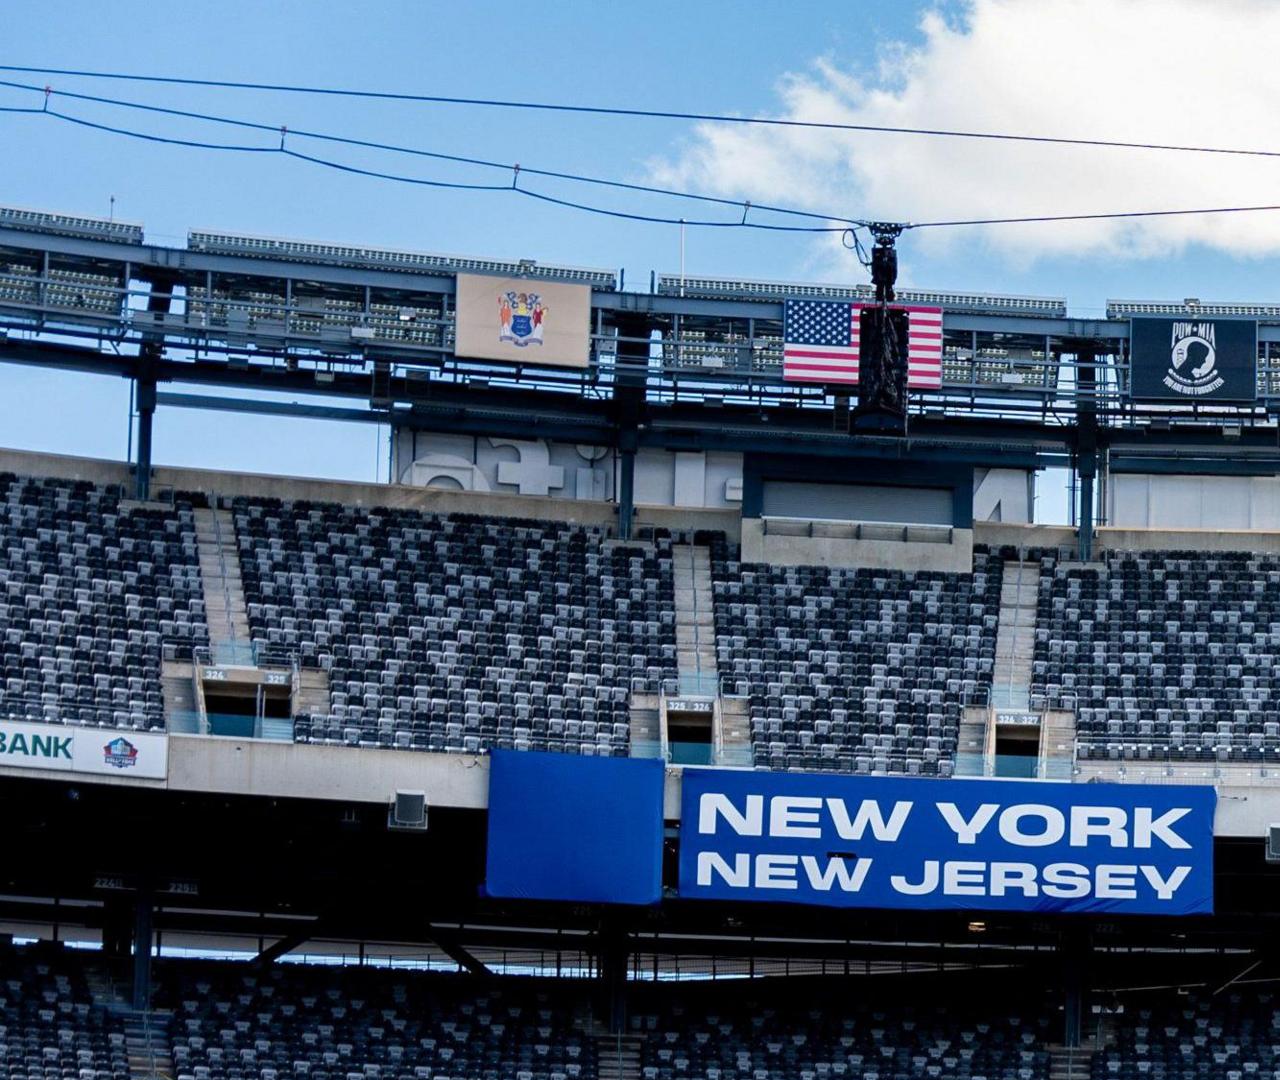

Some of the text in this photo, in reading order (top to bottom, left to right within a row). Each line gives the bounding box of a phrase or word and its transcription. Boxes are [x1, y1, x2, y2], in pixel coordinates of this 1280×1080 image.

[1171, 322, 1217, 350] POW MIA
[698, 792, 1193, 849] NEW YORK
[697, 851, 1192, 900] NEW JERSEY
